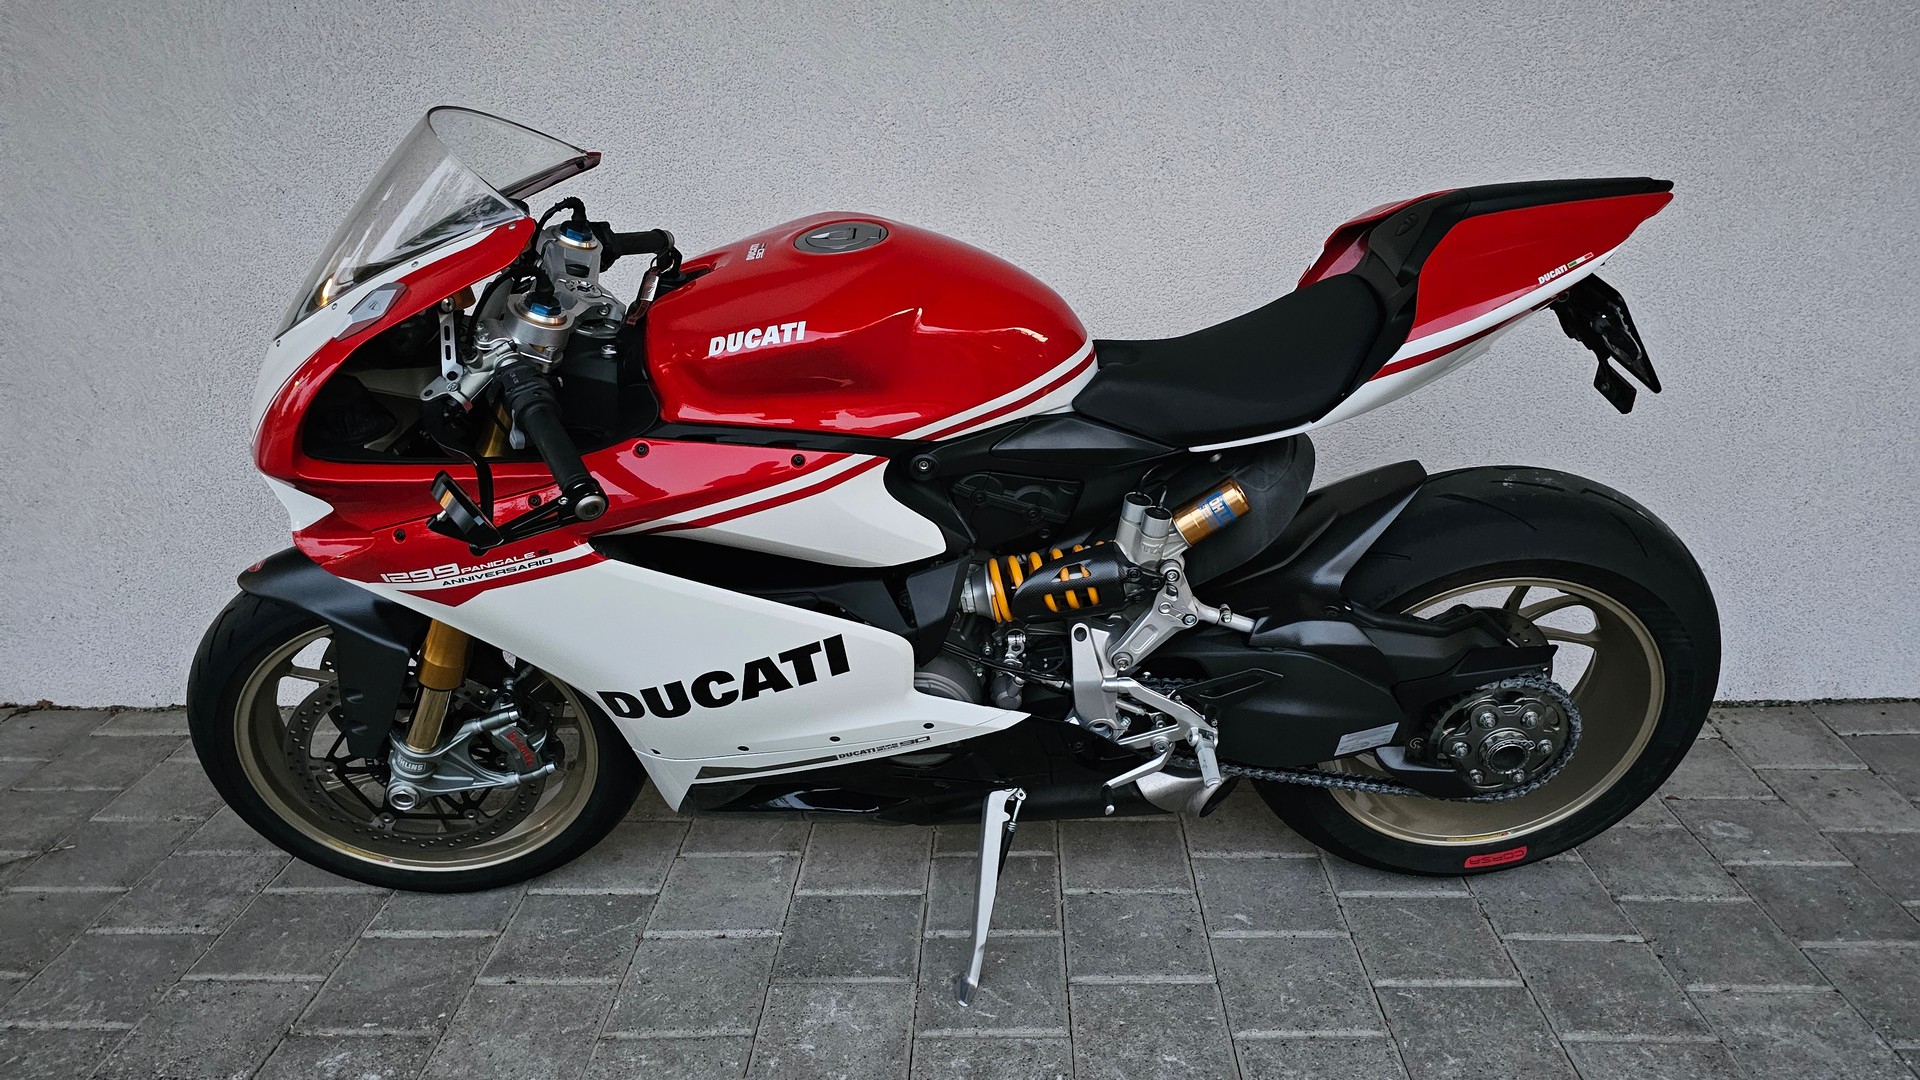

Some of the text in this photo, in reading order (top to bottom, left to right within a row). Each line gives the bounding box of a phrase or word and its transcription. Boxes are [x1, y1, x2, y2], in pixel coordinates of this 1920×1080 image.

[1537, 264, 1568, 284] DUCATI
[708, 321, 807, 357] DUCATI
[380, 562, 461, 583] 1299
[461, 551, 536, 574] PANIGALE
[442, 557, 553, 586] ANNIVERSARIO
[596, 633, 851, 719] DUCATI
[838, 747, 876, 759] DUCATI
[1469, 849, 1525, 865] CORSA
